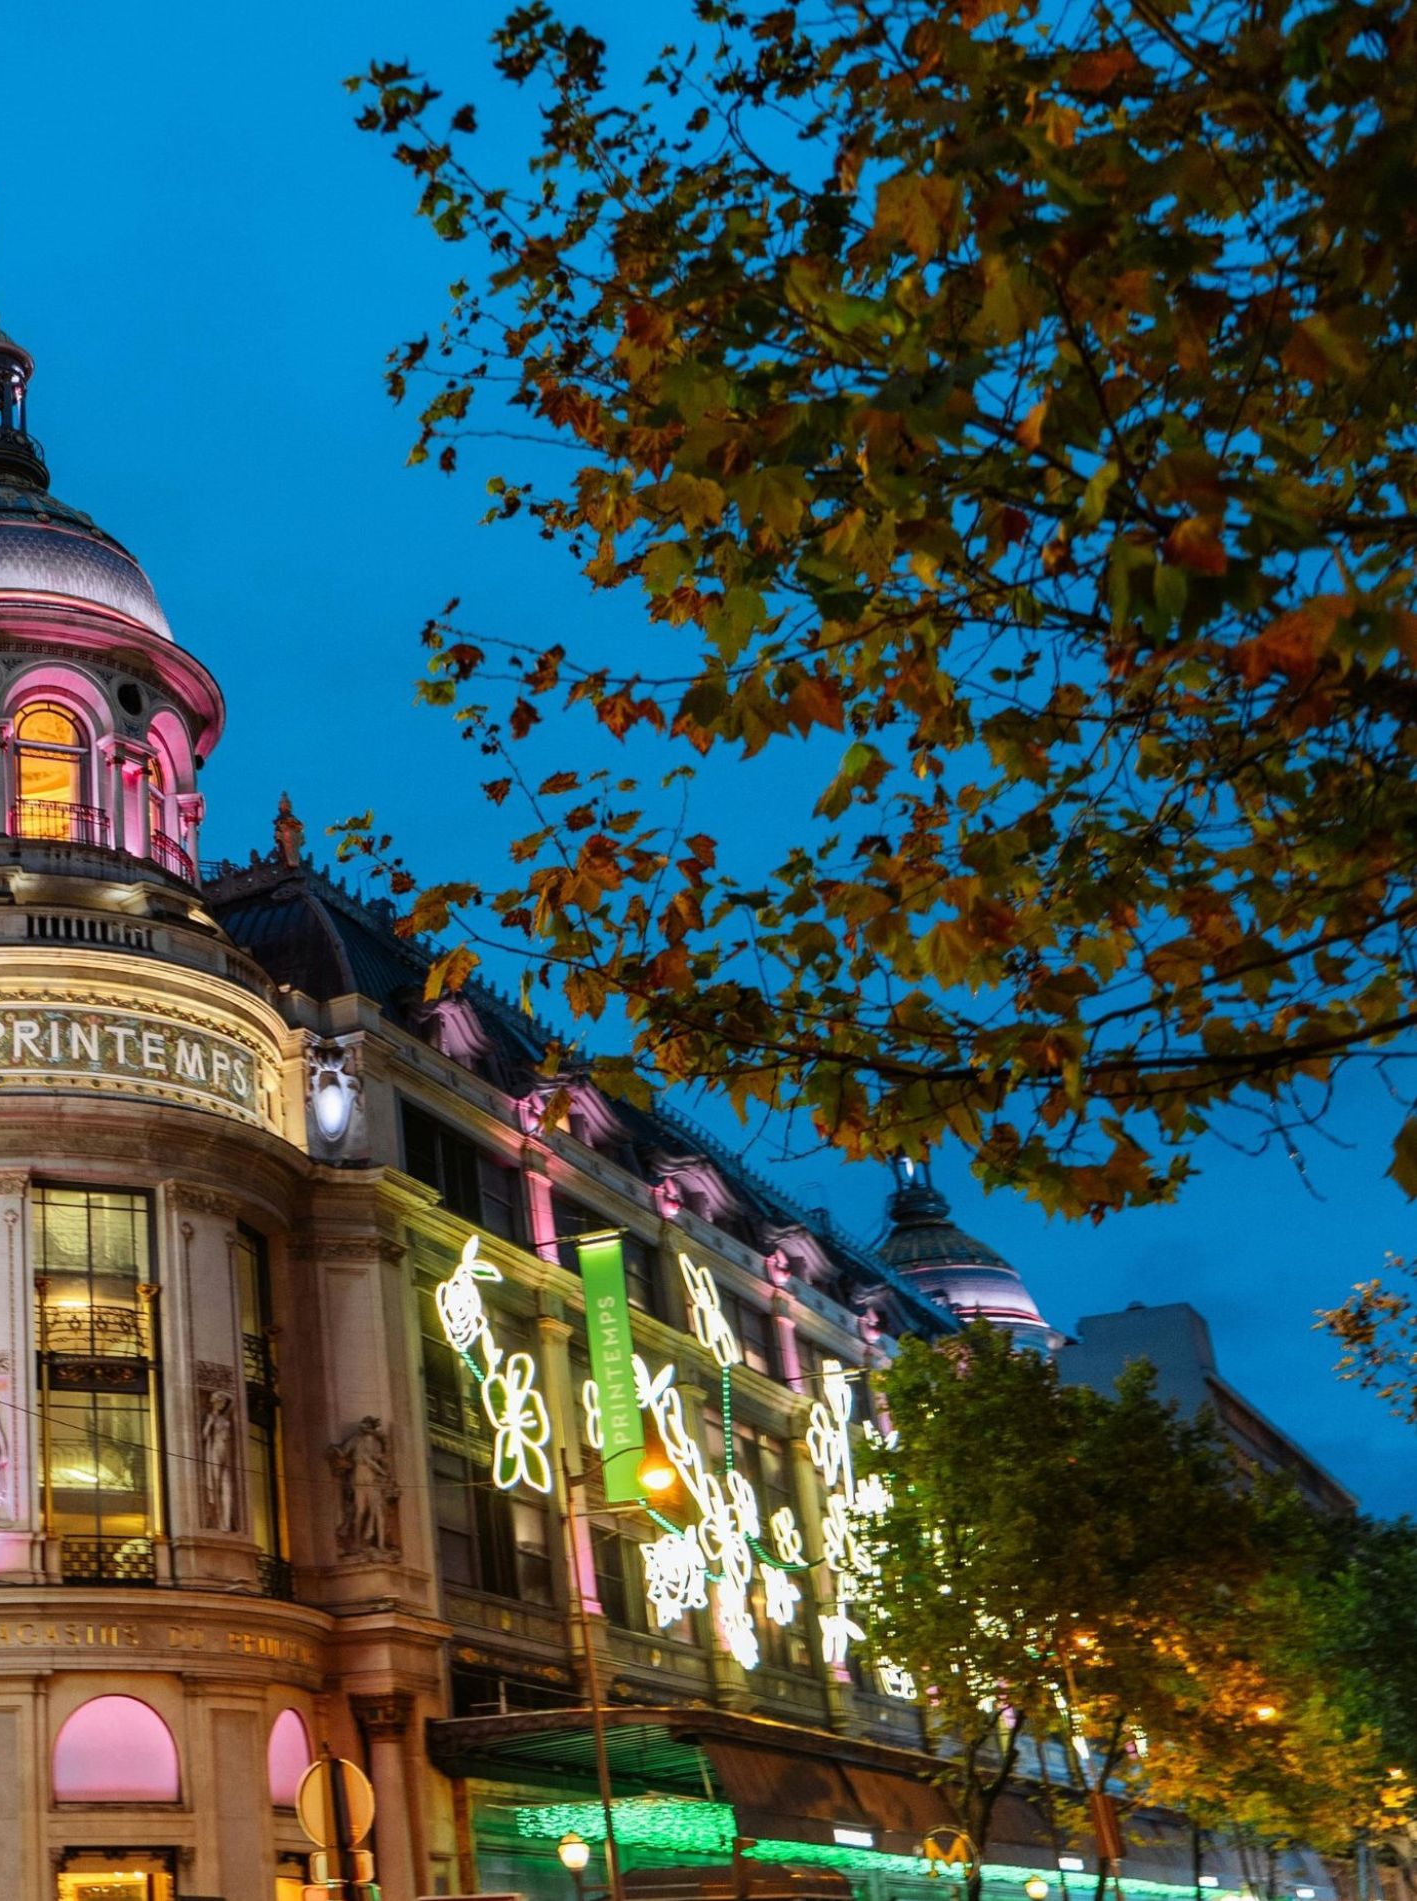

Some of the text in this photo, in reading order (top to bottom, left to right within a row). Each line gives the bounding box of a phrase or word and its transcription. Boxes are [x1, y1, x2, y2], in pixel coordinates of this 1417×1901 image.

[597, 1295, 632, 1447] PRINTEMPS
[167, 1625, 205, 1650] DU
[923, 1832, 974, 1879] M
